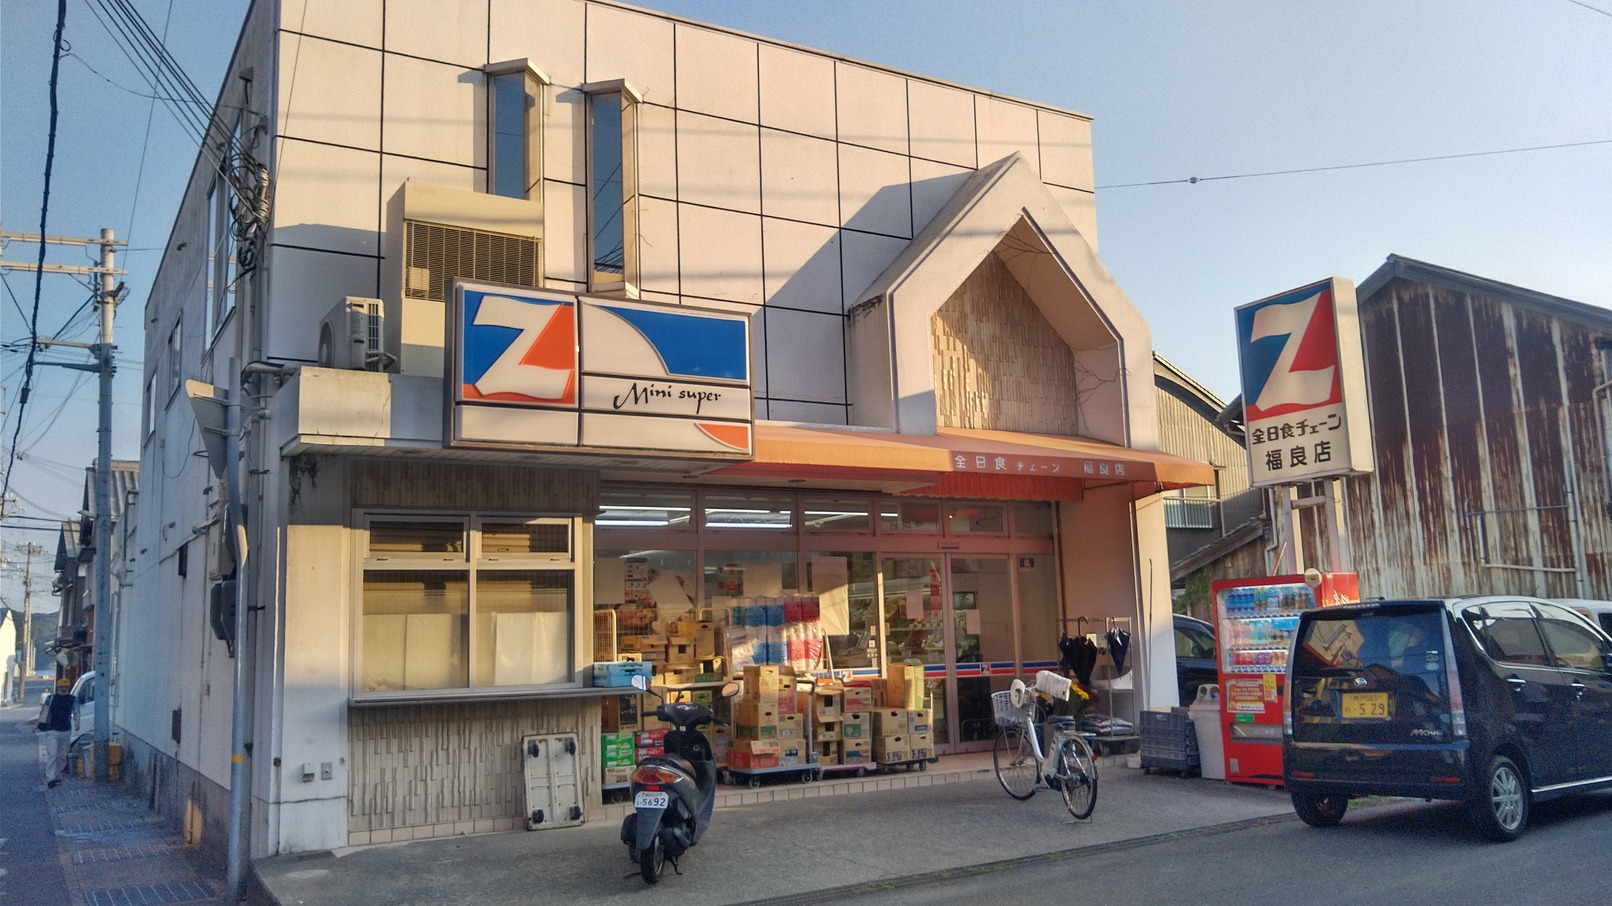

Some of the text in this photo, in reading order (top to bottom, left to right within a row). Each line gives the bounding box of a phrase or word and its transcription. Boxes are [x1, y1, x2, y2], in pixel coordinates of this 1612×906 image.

[613, 382, 722, 414] Mini super
[1251, 413, 1342, 445] 全日食チェーン
[1083, 460, 1125, 476] 福良店
[1265, 440, 1332, 471] 福良店
[643, 797, 666, 806] 5692
